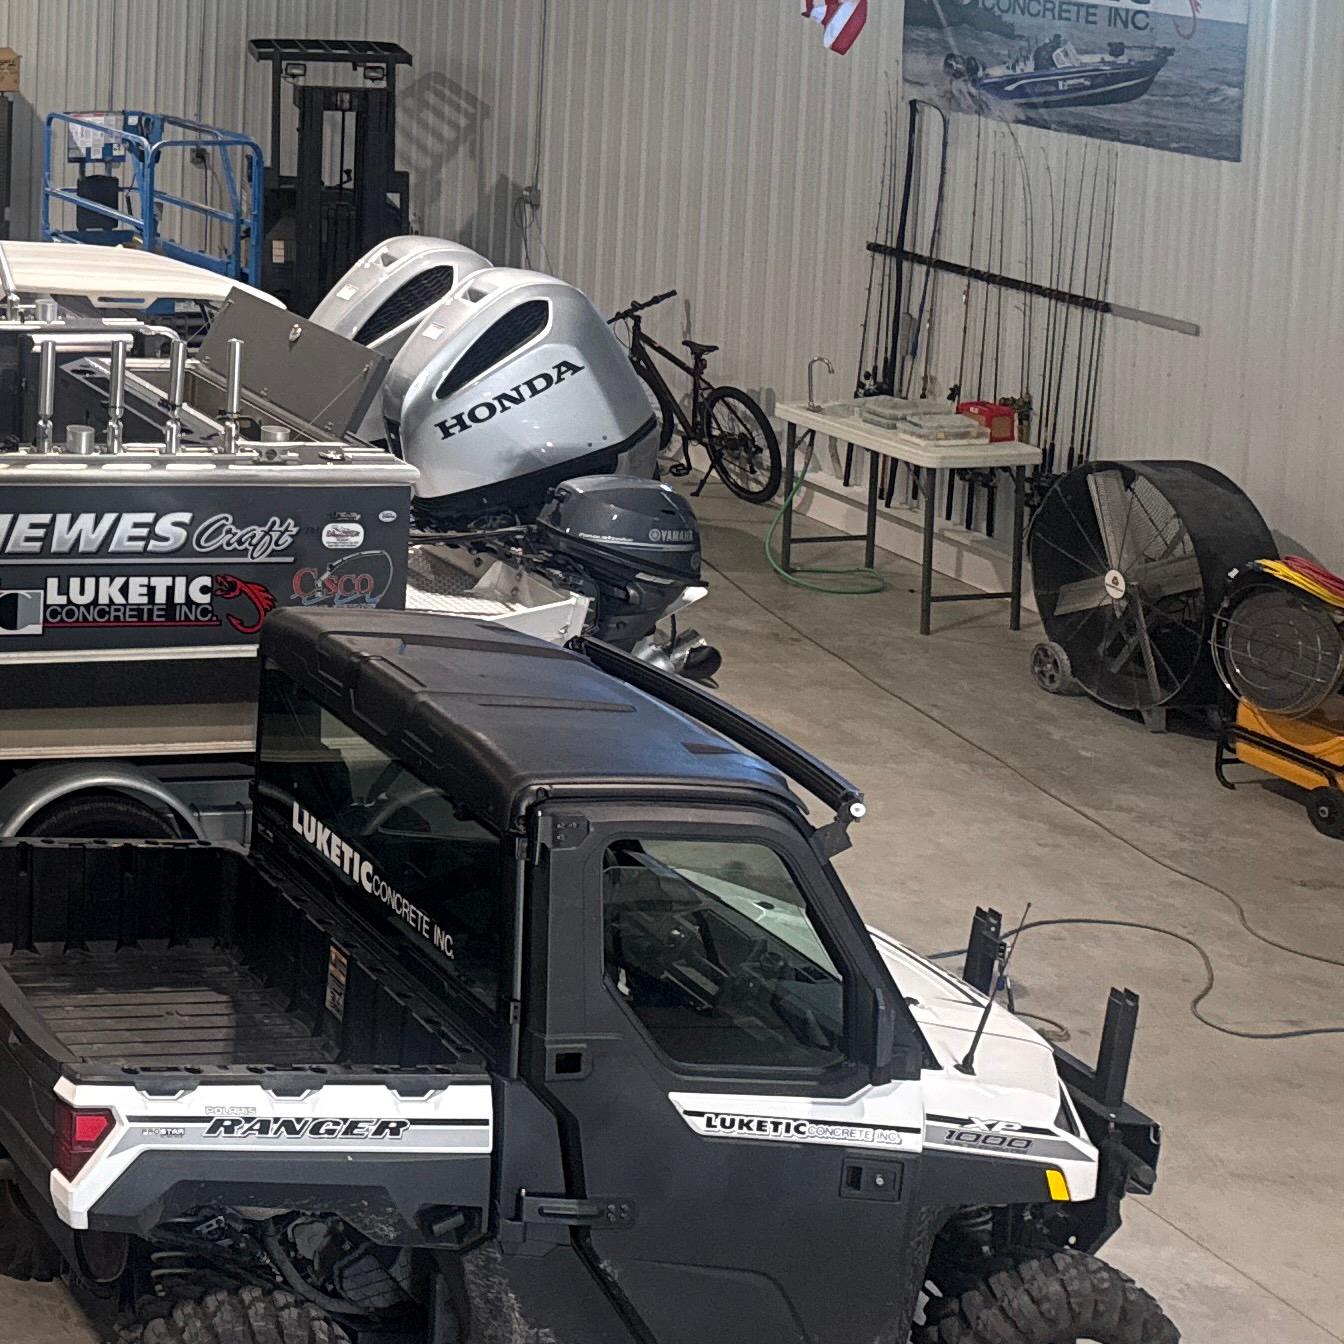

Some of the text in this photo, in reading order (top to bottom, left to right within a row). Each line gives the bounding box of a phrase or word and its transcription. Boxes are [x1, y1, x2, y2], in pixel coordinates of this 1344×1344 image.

[1107, 7, 1154, 33] INC.
[434, 360, 585, 440] HONDA
[192, 513, 300, 560] Craft
[46, 575, 213, 605] LUKETIC
[46, 605, 217, 622] CONCRETE INC.
[291, 801, 374, 893] LUKETIC
[372, 875, 431, 939] CONCRETE
[204, 1106, 257, 1116] POLARIS
[963, 1115, 1023, 1133] XP
[202, 1116, 410, 1139] RANGER
[704, 1113, 809, 1136] LUKETIC
[807, 1124, 874, 1142] CONCRETE
[945, 1129, 1032, 1150] 1000
